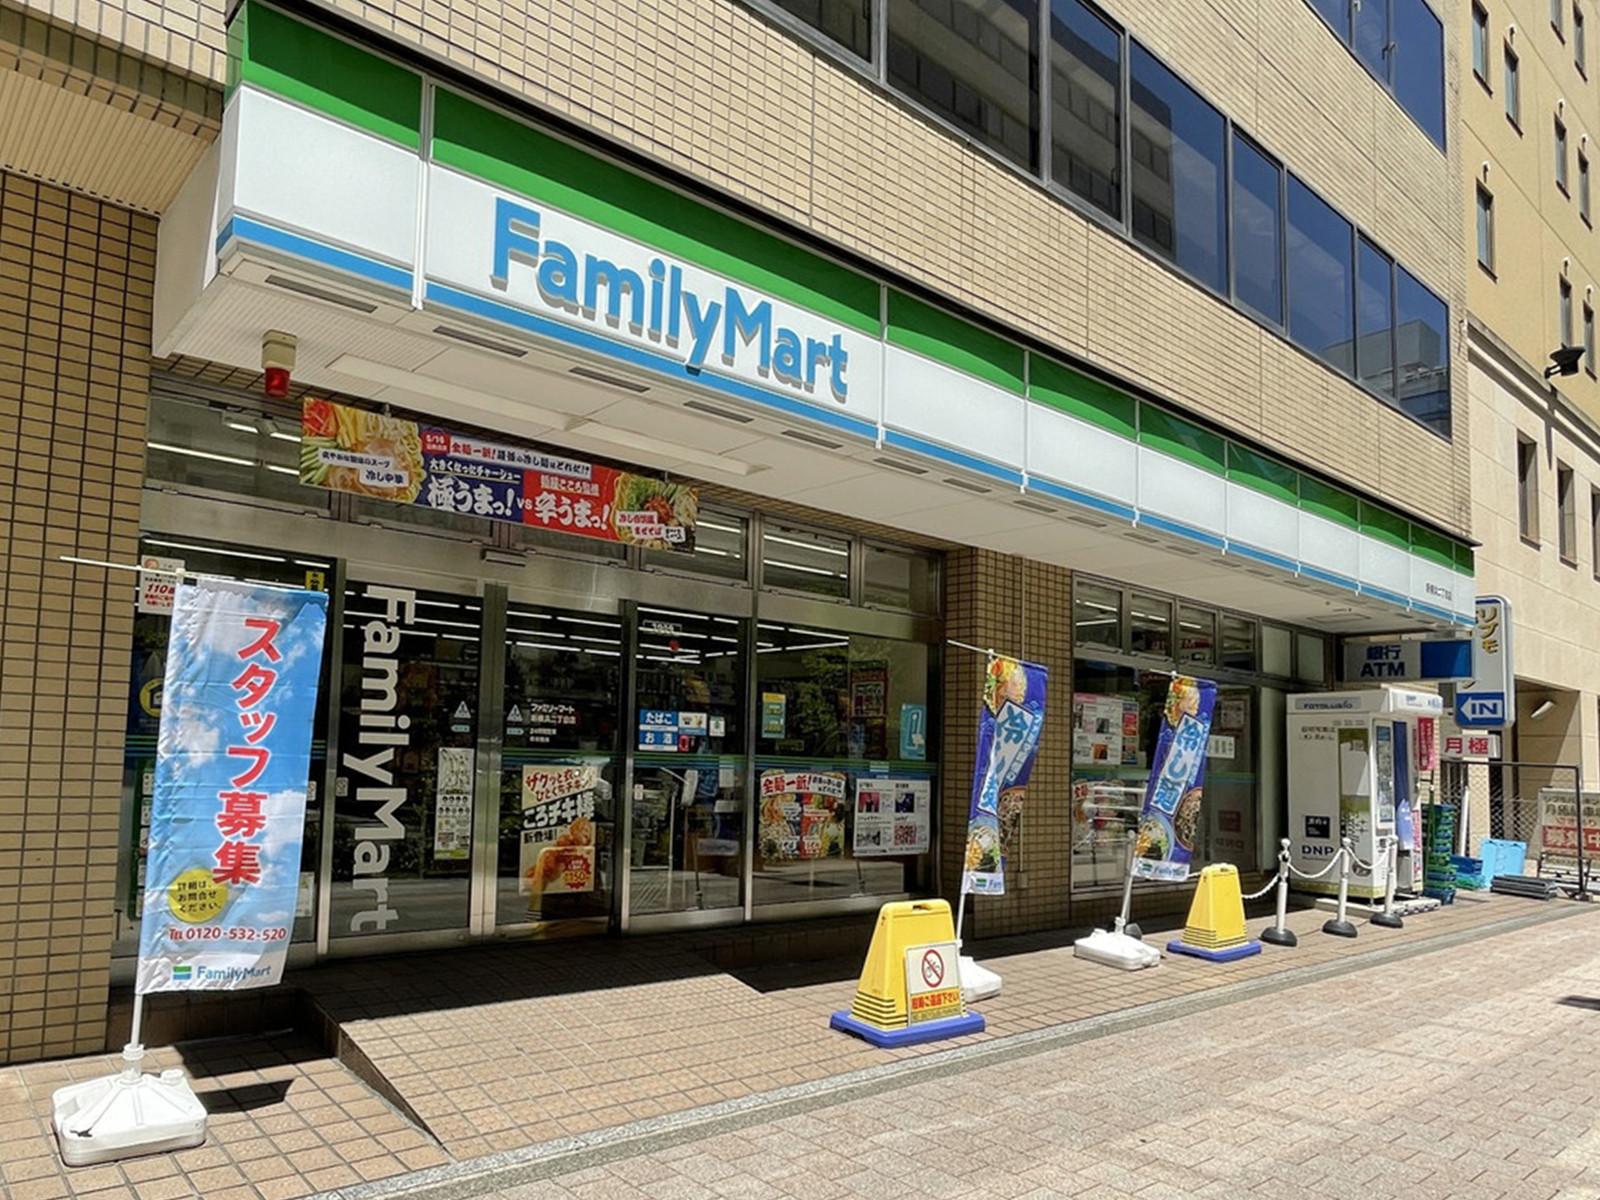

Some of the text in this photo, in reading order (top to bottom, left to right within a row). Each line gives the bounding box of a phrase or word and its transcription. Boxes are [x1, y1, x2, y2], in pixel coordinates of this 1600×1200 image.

[492, 197, 848, 400] FamilyMart
[365, 470, 404, 484] 冷し中華
[1366, 644, 1401, 660] 銀行
[1361, 661, 1405, 677] ATM
[1471, 703, 1497, 715] IN
[646, 712, 673, 725] たばこ
[213, 617, 283, 886] スタッフ募集
[1444, 737, 1489, 754] 月極
[343, 585, 416, 932] FamilyMart
[1153, 716, 1202, 812] 冷し麺
[1302, 845, 1334, 855] DNP
[178, 890, 217, 902] お問合せ
[186, 927, 286, 941] 0120-532-520
[197, 965, 271, 981] FamilyMart
